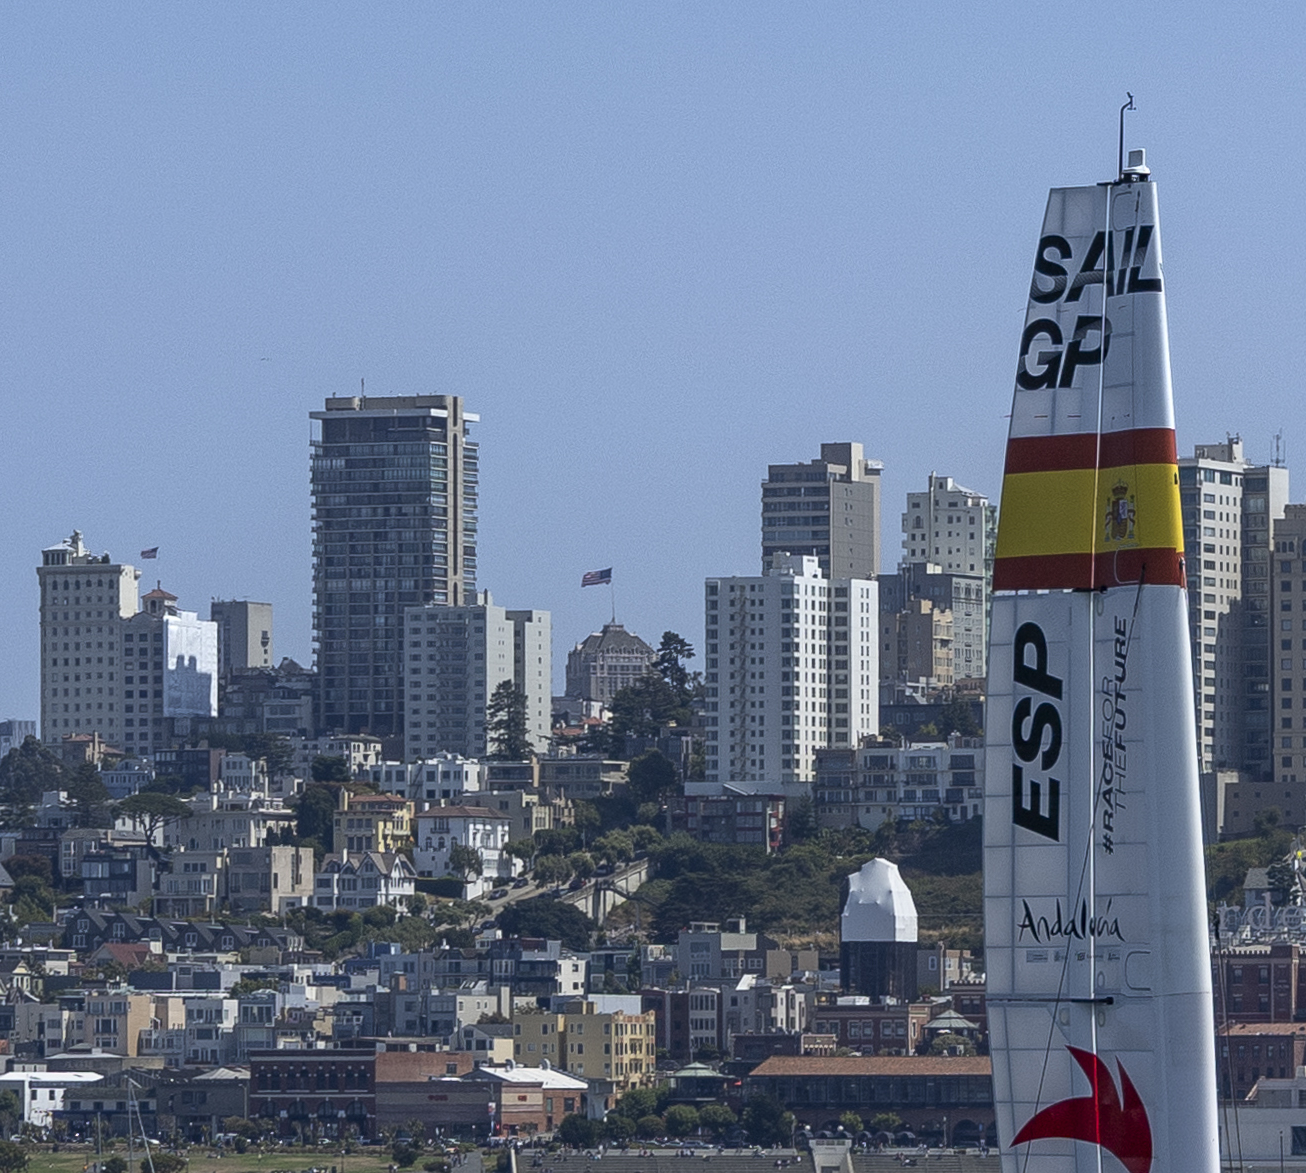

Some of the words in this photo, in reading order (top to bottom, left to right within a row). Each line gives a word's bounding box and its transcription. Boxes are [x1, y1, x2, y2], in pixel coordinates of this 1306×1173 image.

[1029, 224, 1162, 304] SAIL
[1016, 315, 1113, 391] GP
[1011, 621, 1063, 842] ESP
